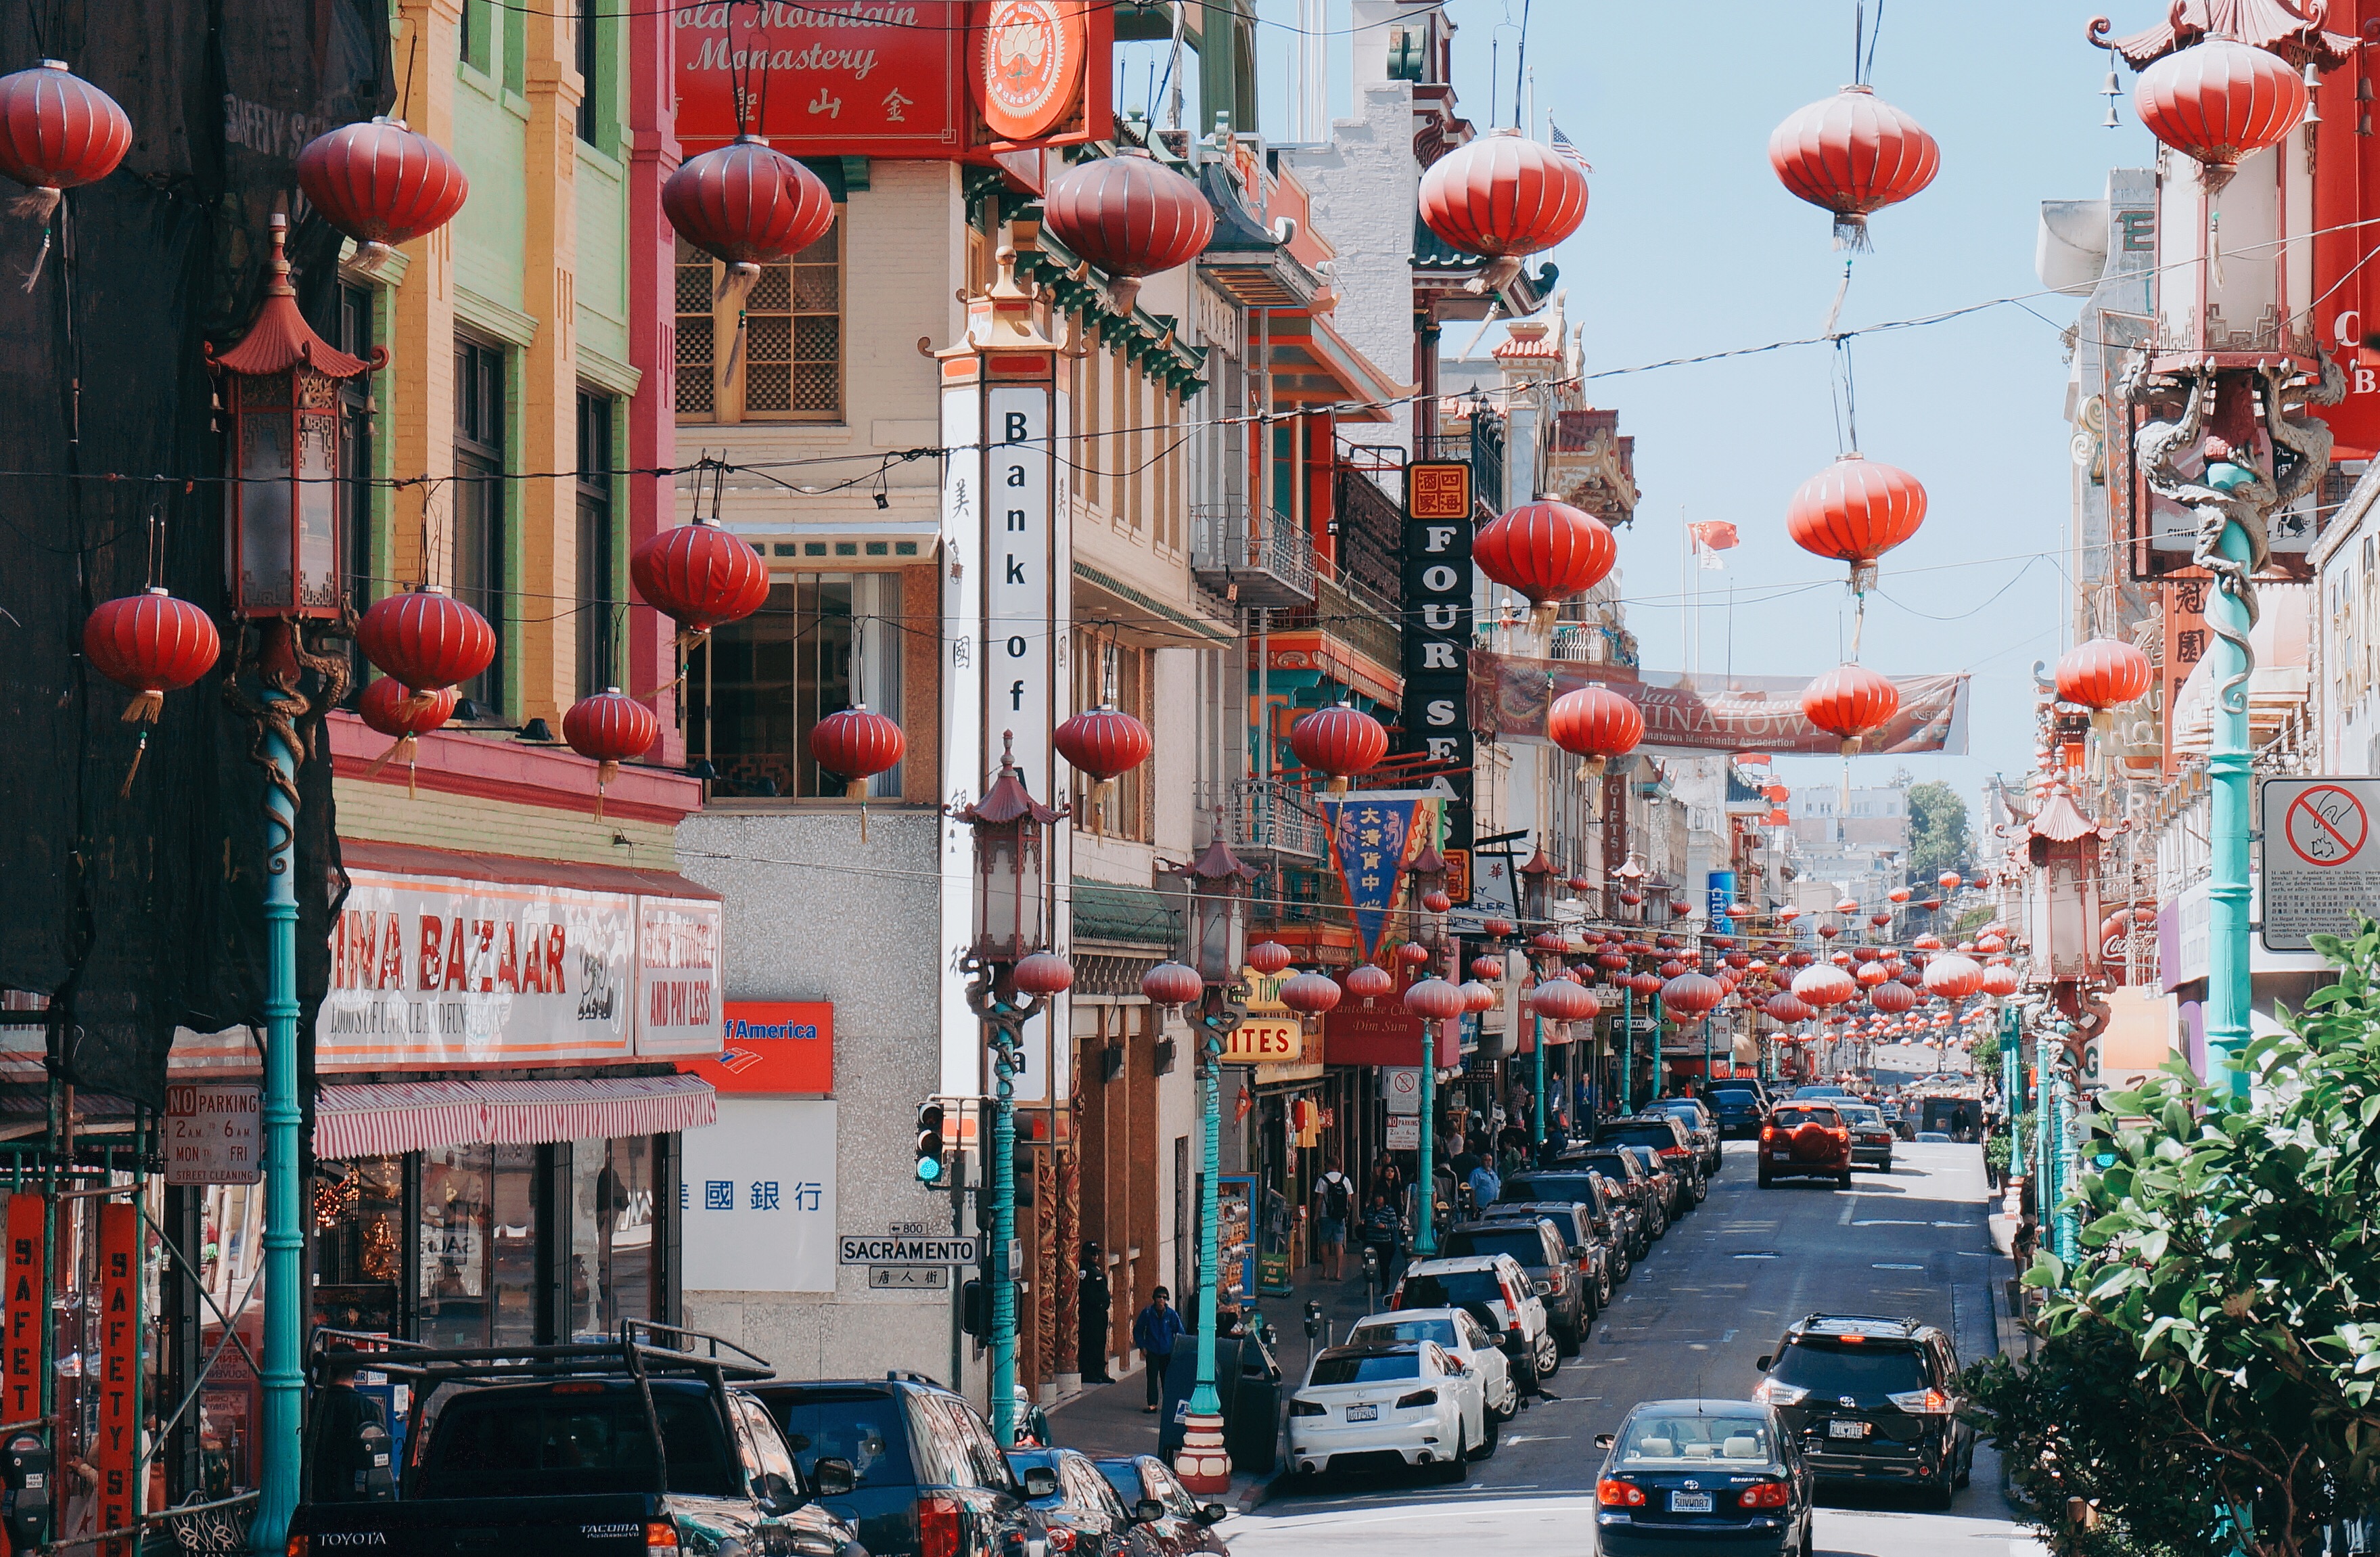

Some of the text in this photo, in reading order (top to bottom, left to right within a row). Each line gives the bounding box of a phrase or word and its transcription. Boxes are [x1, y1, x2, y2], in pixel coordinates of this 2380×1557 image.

[676, 1, 918, 28] old Mountain
[687, 37, 878, 81] Monastery
[1005, 412, 1027, 711] Bank of
[1421, 526, 1459, 669] FOUR
[1640, 703, 1835, 737] INATOW
[337, 910, 405, 991] INA
[418, 915, 566, 993] BAZAAR
[650, 979, 710, 1026] AND PAY LESS
[737, 1020, 817, 1040] America
[1353, 1020, 1408, 1032] Dim Sum
[1232, 1029, 1289, 1054] ITES
[170, 1089, 256, 1113] NO PARKING
[176, 1120, 186, 1138] 2
[225, 1120, 233, 1137] 6
[1388, 1118, 1396, 1126] NO
[176, 1146, 199, 1158] MON
[230, 1146, 248, 1158] FRI
[176, 1171, 253, 1180] STREET CLEANING
[903, 1224, 923, 1234] 800
[844, 1242, 974, 1259] SACRAMENTO
[877, 1270, 938, 1284] 唐人街
[14, 1238, 32, 1410] SAFET
[108, 1253, 129, 1451] SAFETY
[319, 1533, 387, 1545] TOYOTA
[580, 1524, 639, 1533] TACOMA
